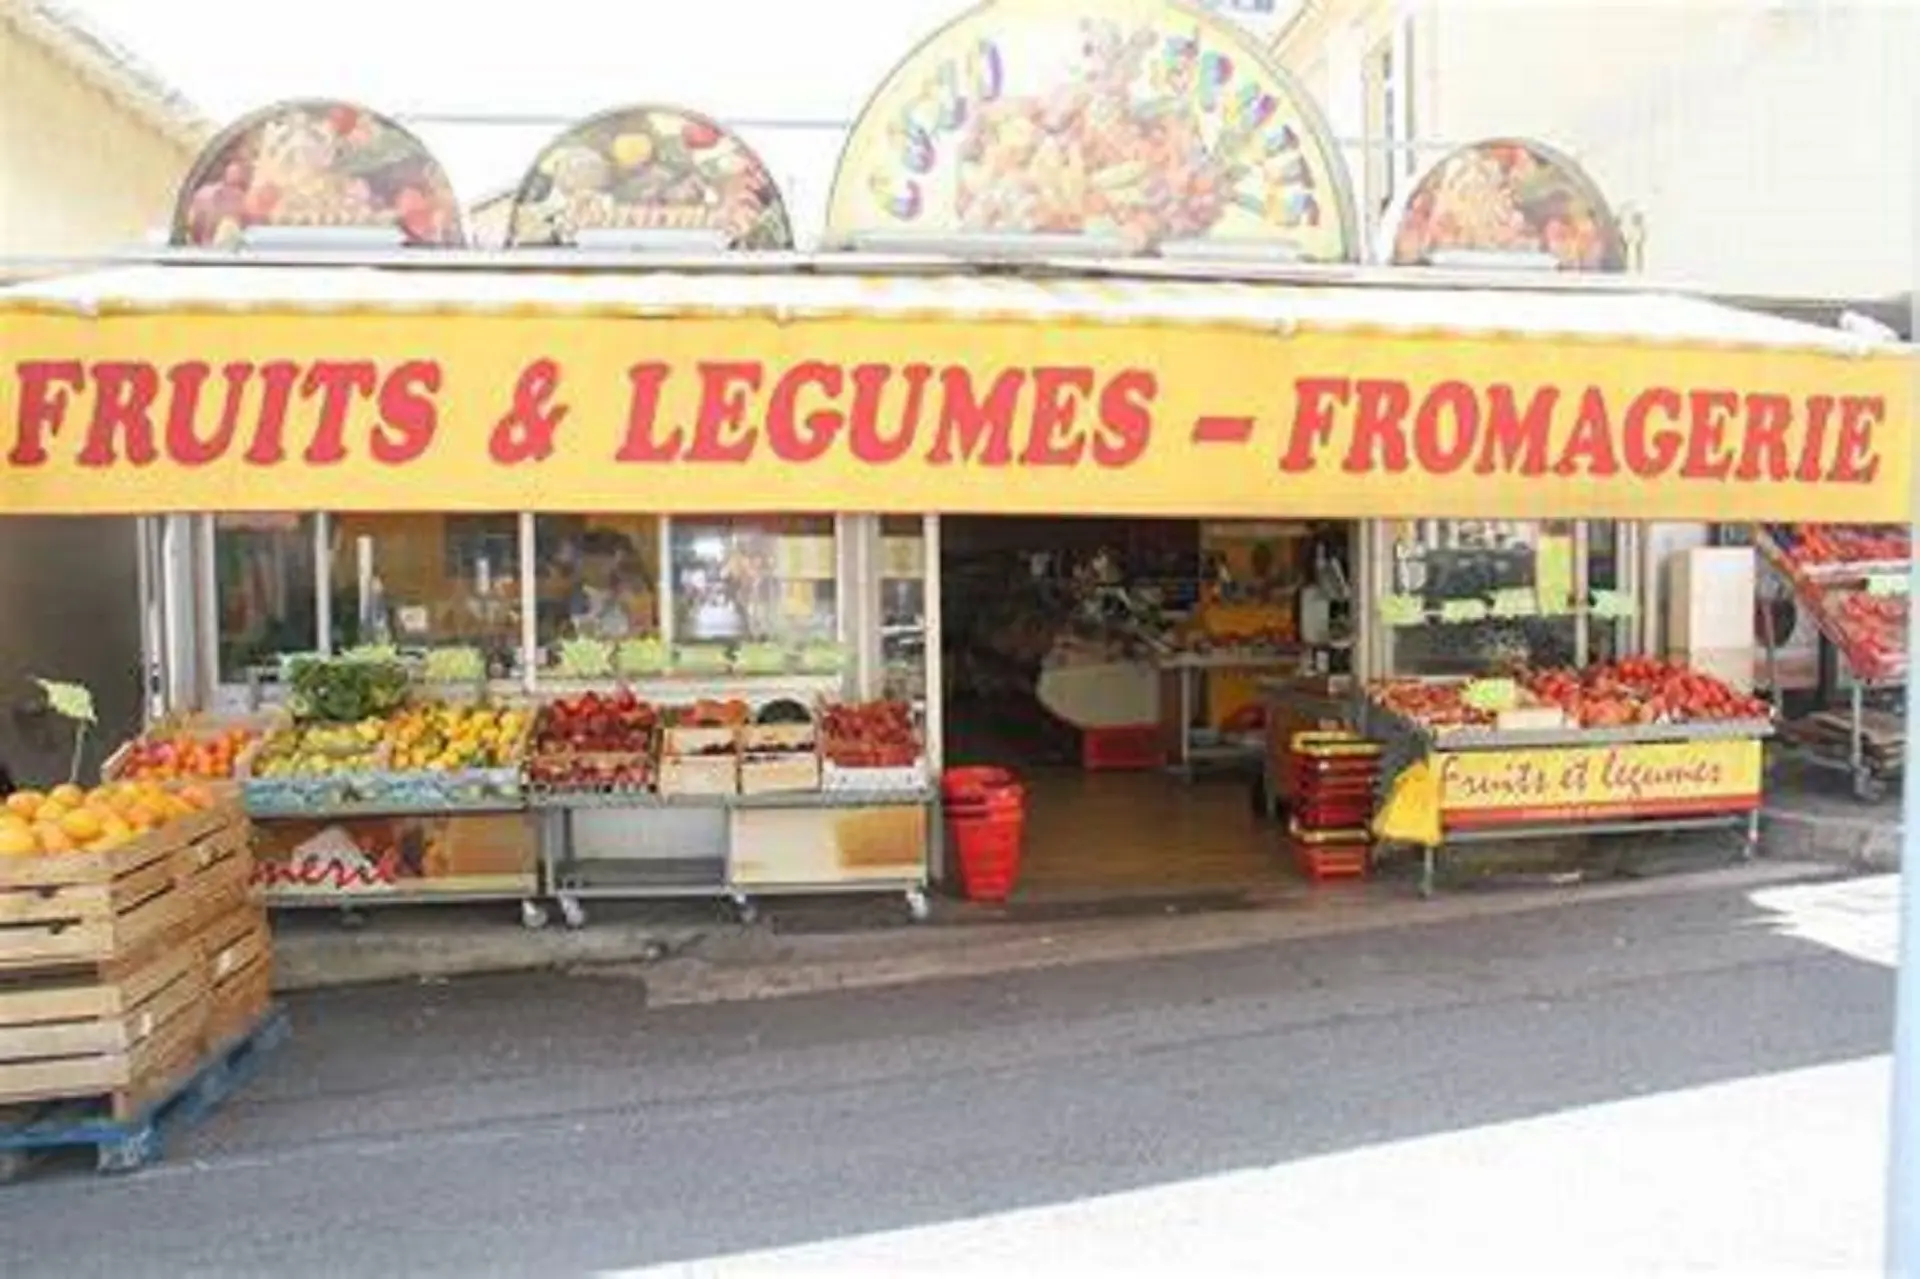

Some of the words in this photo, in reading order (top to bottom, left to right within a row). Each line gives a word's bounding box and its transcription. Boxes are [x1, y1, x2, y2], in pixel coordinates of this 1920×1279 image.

[8, 360, 443, 467] FRUITS
[489, 360, 567, 466] &
[614, 362, 1155, 467] LEGUMES
[1280, 378, 1884, 482] FROMAGERIE
